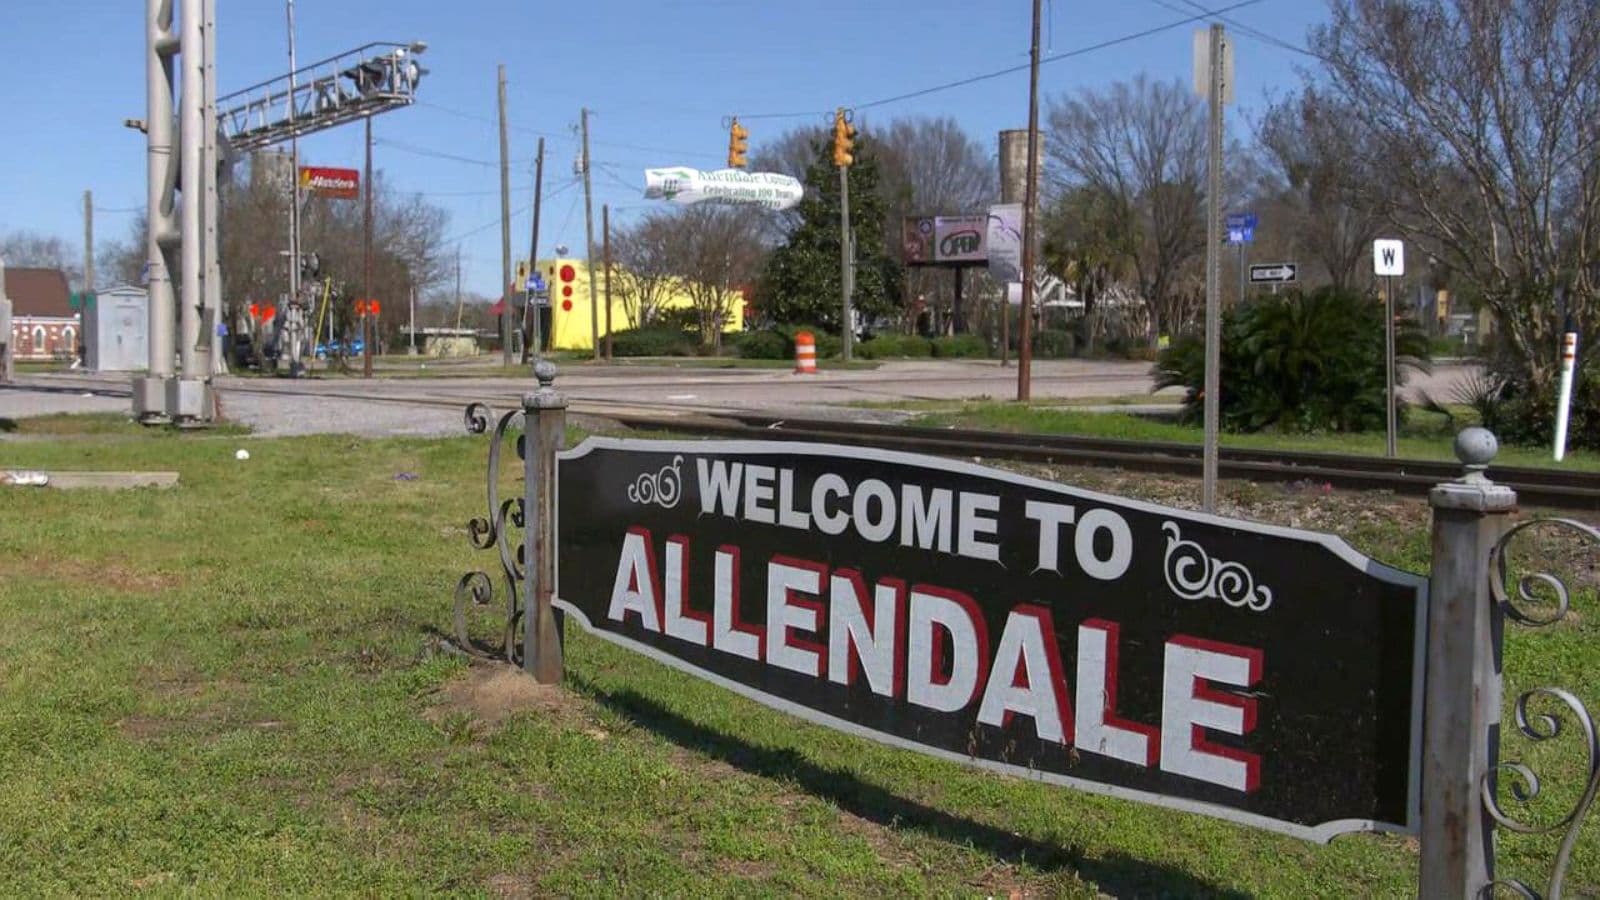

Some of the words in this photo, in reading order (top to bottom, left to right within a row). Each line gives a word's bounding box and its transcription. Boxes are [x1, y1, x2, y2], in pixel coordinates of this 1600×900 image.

[1382, 247, 1396, 267] W
[697, 458, 1000, 562] WELCOME
[1024, 501, 1134, 581] TO
[607, 526, 1264, 793] ALLENDALE
